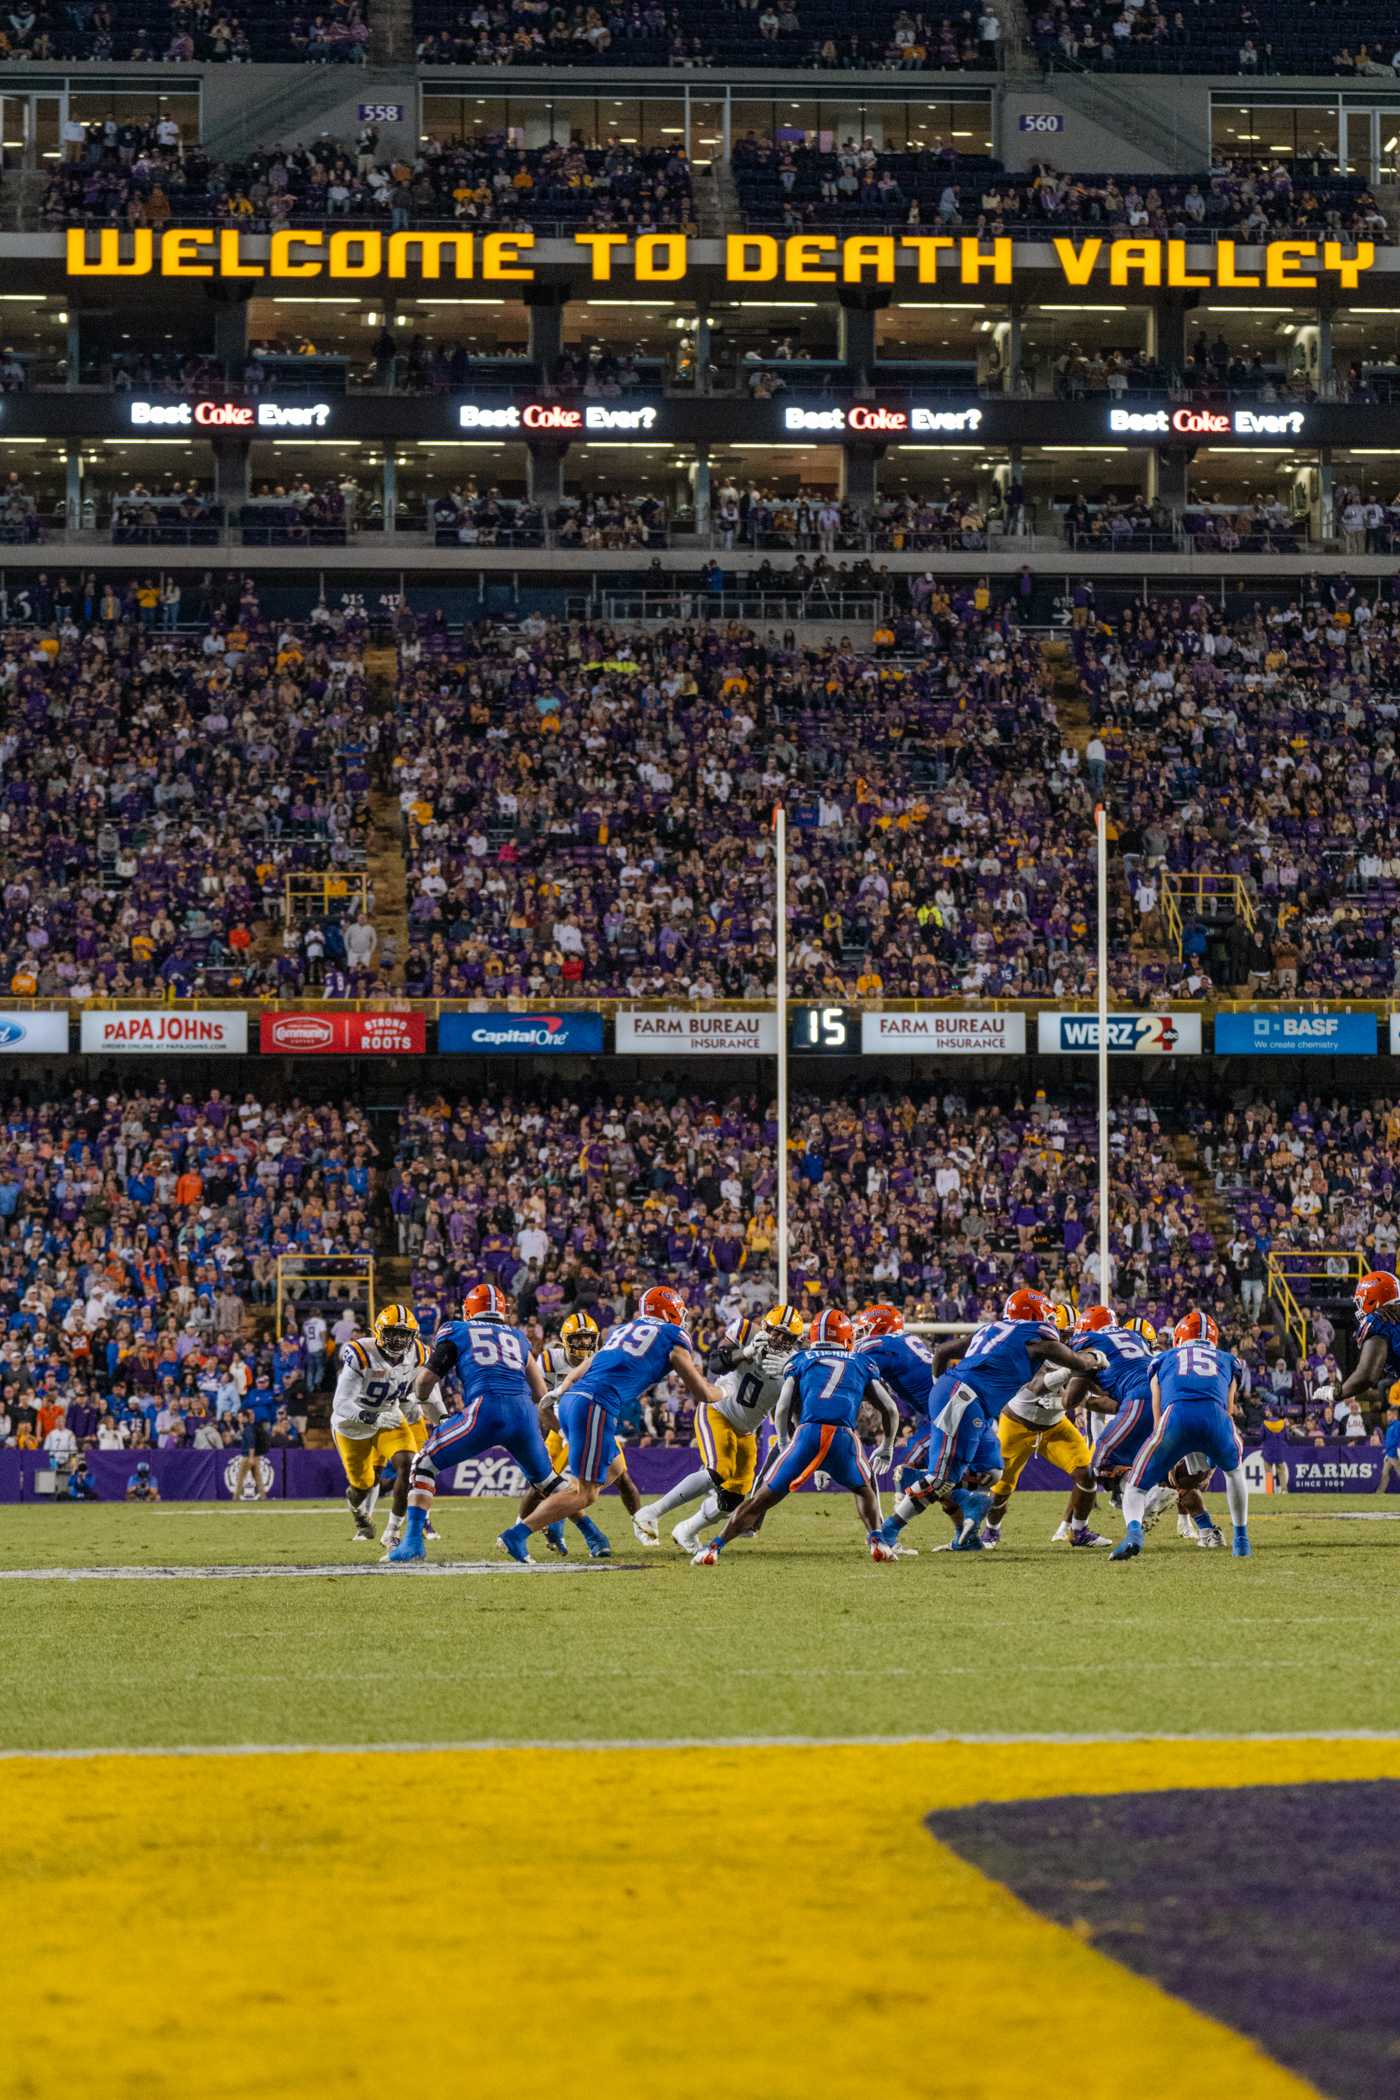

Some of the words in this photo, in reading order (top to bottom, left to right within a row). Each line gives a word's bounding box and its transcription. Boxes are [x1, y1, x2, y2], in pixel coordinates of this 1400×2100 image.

[364, 105, 399, 121] 558
[1025, 115, 1059, 131] 560
[66, 228, 535, 281] WELCOME
[574, 232, 688, 281] TO
[726, 234, 1014, 284] DEATH
[1052, 237, 1375, 289] VALLEY
[131, 402, 192, 424] Best
[194, 402, 254, 425] Coke
[258, 403, 330, 426] Ever?
[459, 405, 520, 427] Best
[523, 405, 582, 428] Coke
[586, 406, 657, 429] Ever?
[785, 407, 845, 429] Best
[848, 407, 907, 430] Coke
[911, 408, 983, 431] Ever?
[1110, 409, 1169, 431] Best
[1173, 409, 1231, 432] Coke
[1235, 410, 1304, 433] Ever?
[104, 1018, 153, 1040] PAPA
[157, 1017, 224, 1040] JOHNS
[364, 1018, 408, 1031] STRONG
[634, 1018, 683, 1034] FARM
[690, 1018, 759, 1033] BUREAU
[810, 1008, 846, 1046] 15
[880, 1018, 929, 1033] FARM
[935, 1018, 1005, 1033] BUREAU
[1283, 1019, 1338, 1036] BASF
[361, 1036, 412, 1049] ROOTS
[691, 1038, 760, 1049] INSURANCE
[937, 1038, 1006, 1049] INSURANCE
[1135, 1017, 1164, 1054] 2
[1254, 1041, 1268, 1049] We
[1269, 1041, 1296, 1049] create
[1297, 1040, 1338, 1050] chemistry
[307, 1326, 316, 1341] 9
[602, 1322, 659, 1357] 89
[468, 1327, 522, 1372] 58
[1176, 1347, 1218, 1377] 15
[819, 1358, 846, 1399] 7
[736, 1372, 764, 1409] 0
[1295, 1463, 1372, 1478] FARMS
[1295, 1480, 1321, 1488] SINCE
